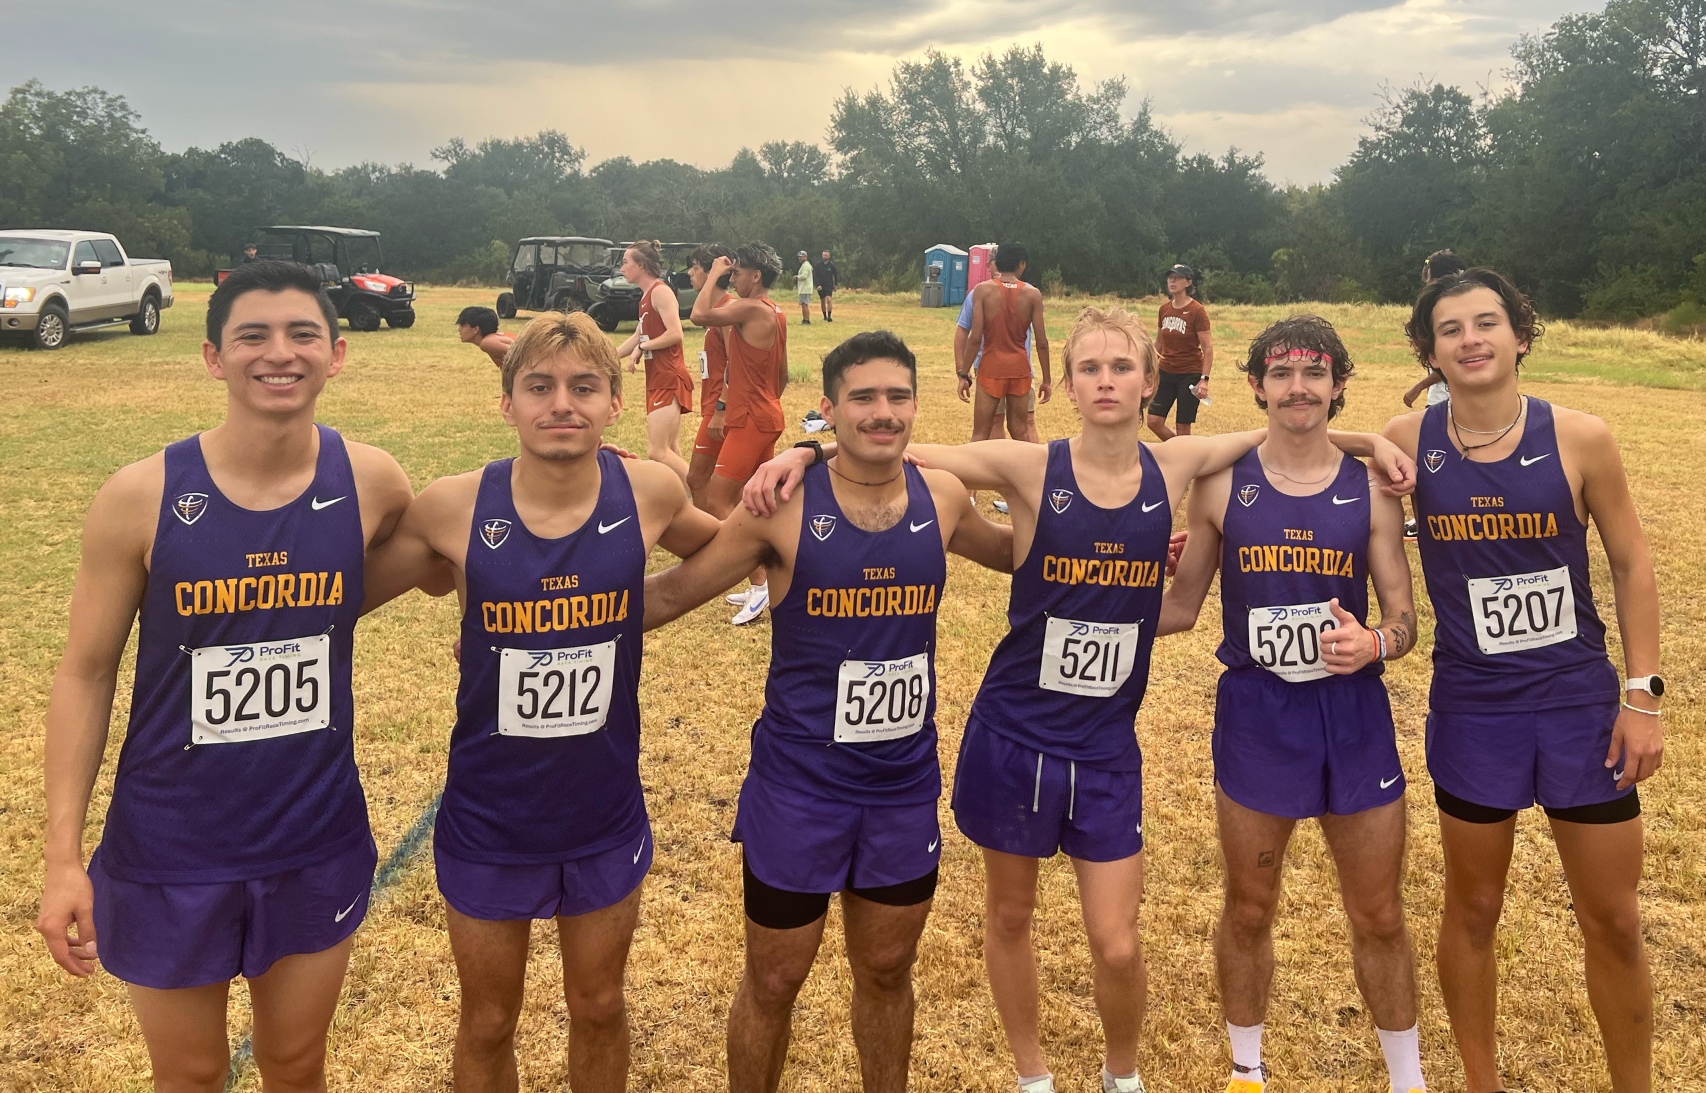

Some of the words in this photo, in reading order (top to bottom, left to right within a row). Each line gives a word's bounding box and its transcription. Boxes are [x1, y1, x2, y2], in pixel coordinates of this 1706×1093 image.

[1470, 496, 1504, 508] TEXAS
[1284, 528, 1313, 541] TEXAS
[1427, 512, 1559, 541] CONCORDIA
[246, 551, 288, 568] TEXAS
[1094, 542, 1124, 554] TEXAS
[1043, 555, 1160, 588] CONCORDIA
[1238, 545, 1354, 578] CONCORDIA
[541, 575, 579, 591] TEXAS
[863, 567, 896, 580] TEXAS
[1516, 575, 1549, 586] ProFit
[175, 571, 343, 617] CONCORDIA
[807, 584, 936, 618] CONCORDIA
[482, 589, 629, 634] CONCORDIA
[1291, 607, 1321, 616] ProFit
[1481, 586, 1565, 638] 5207
[1093, 625, 1119, 634] ProFit
[260, 643, 301, 656] ProFit
[1257, 619, 1335, 667] 520
[557, 649, 593, 661] ProFit
[889, 660, 914, 672] ProFit
[1060, 637, 1120, 682] 5211
[205, 659, 319, 724] 5205
[517, 665, 601, 719] 5212
[845, 674, 923, 725] 5208
